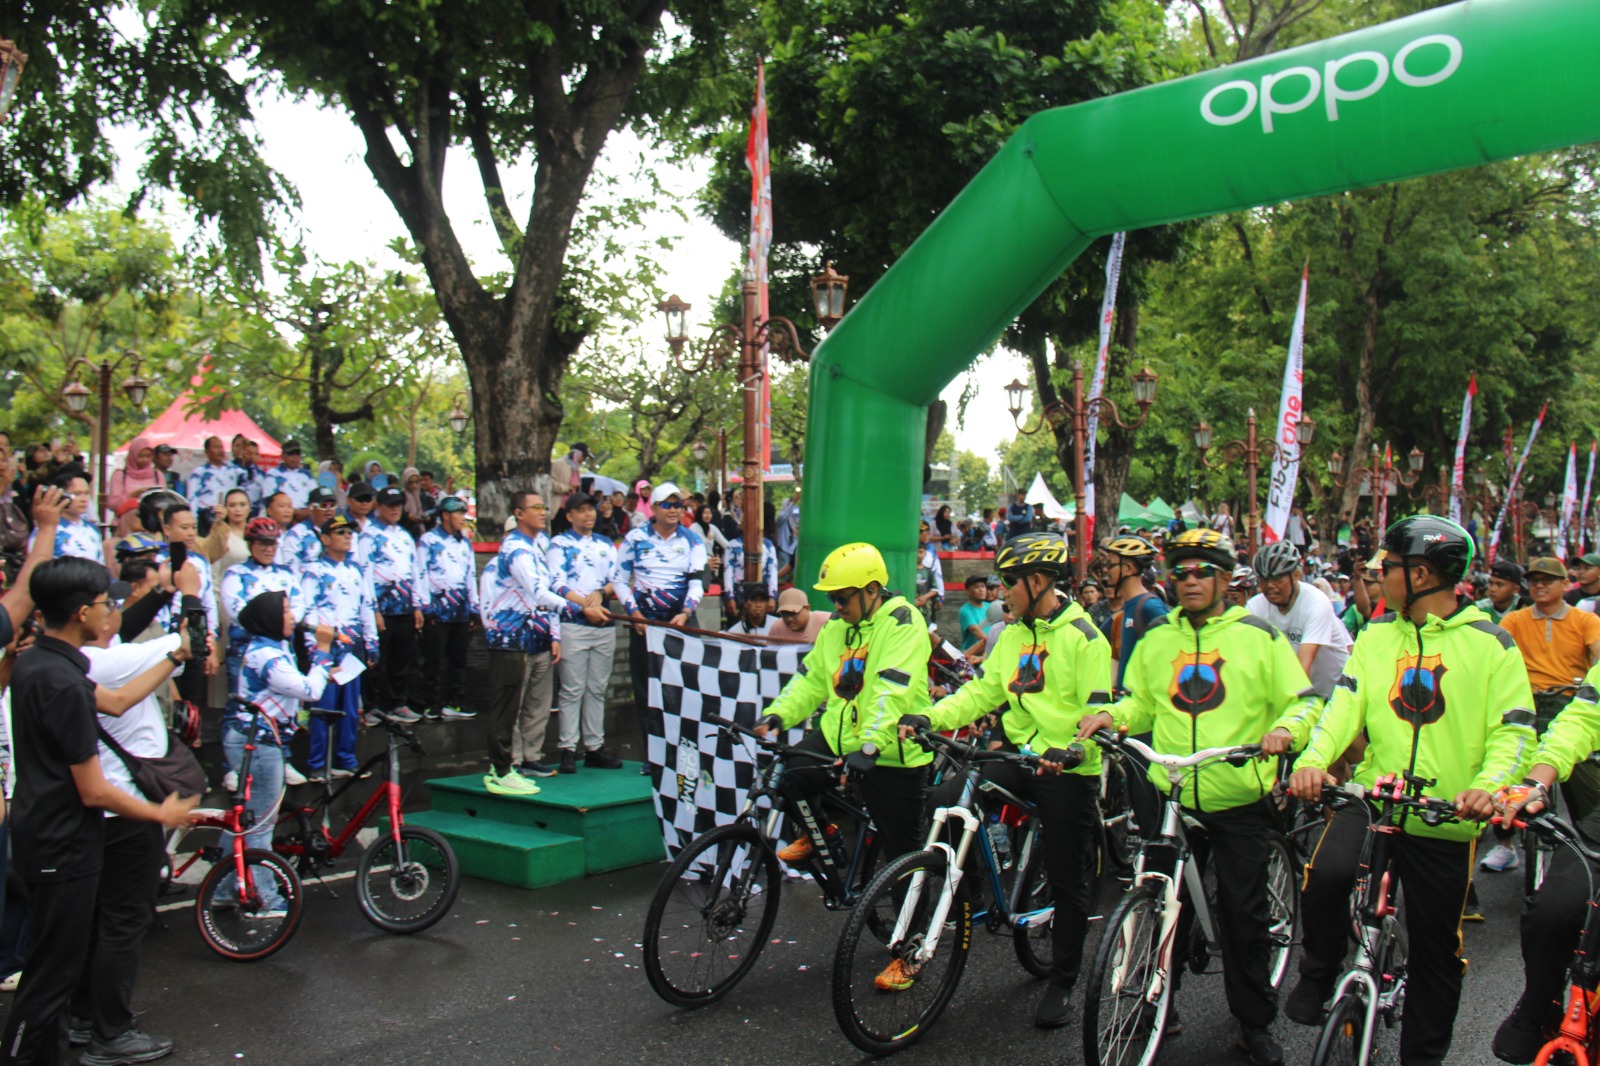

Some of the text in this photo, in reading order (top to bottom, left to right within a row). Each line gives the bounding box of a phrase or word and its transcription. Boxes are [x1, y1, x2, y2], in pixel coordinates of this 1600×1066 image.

[1199, 33, 1464, 134] oppo
[796, 799, 835, 866] GIANT
[962, 901, 971, 950] MAXXIS
